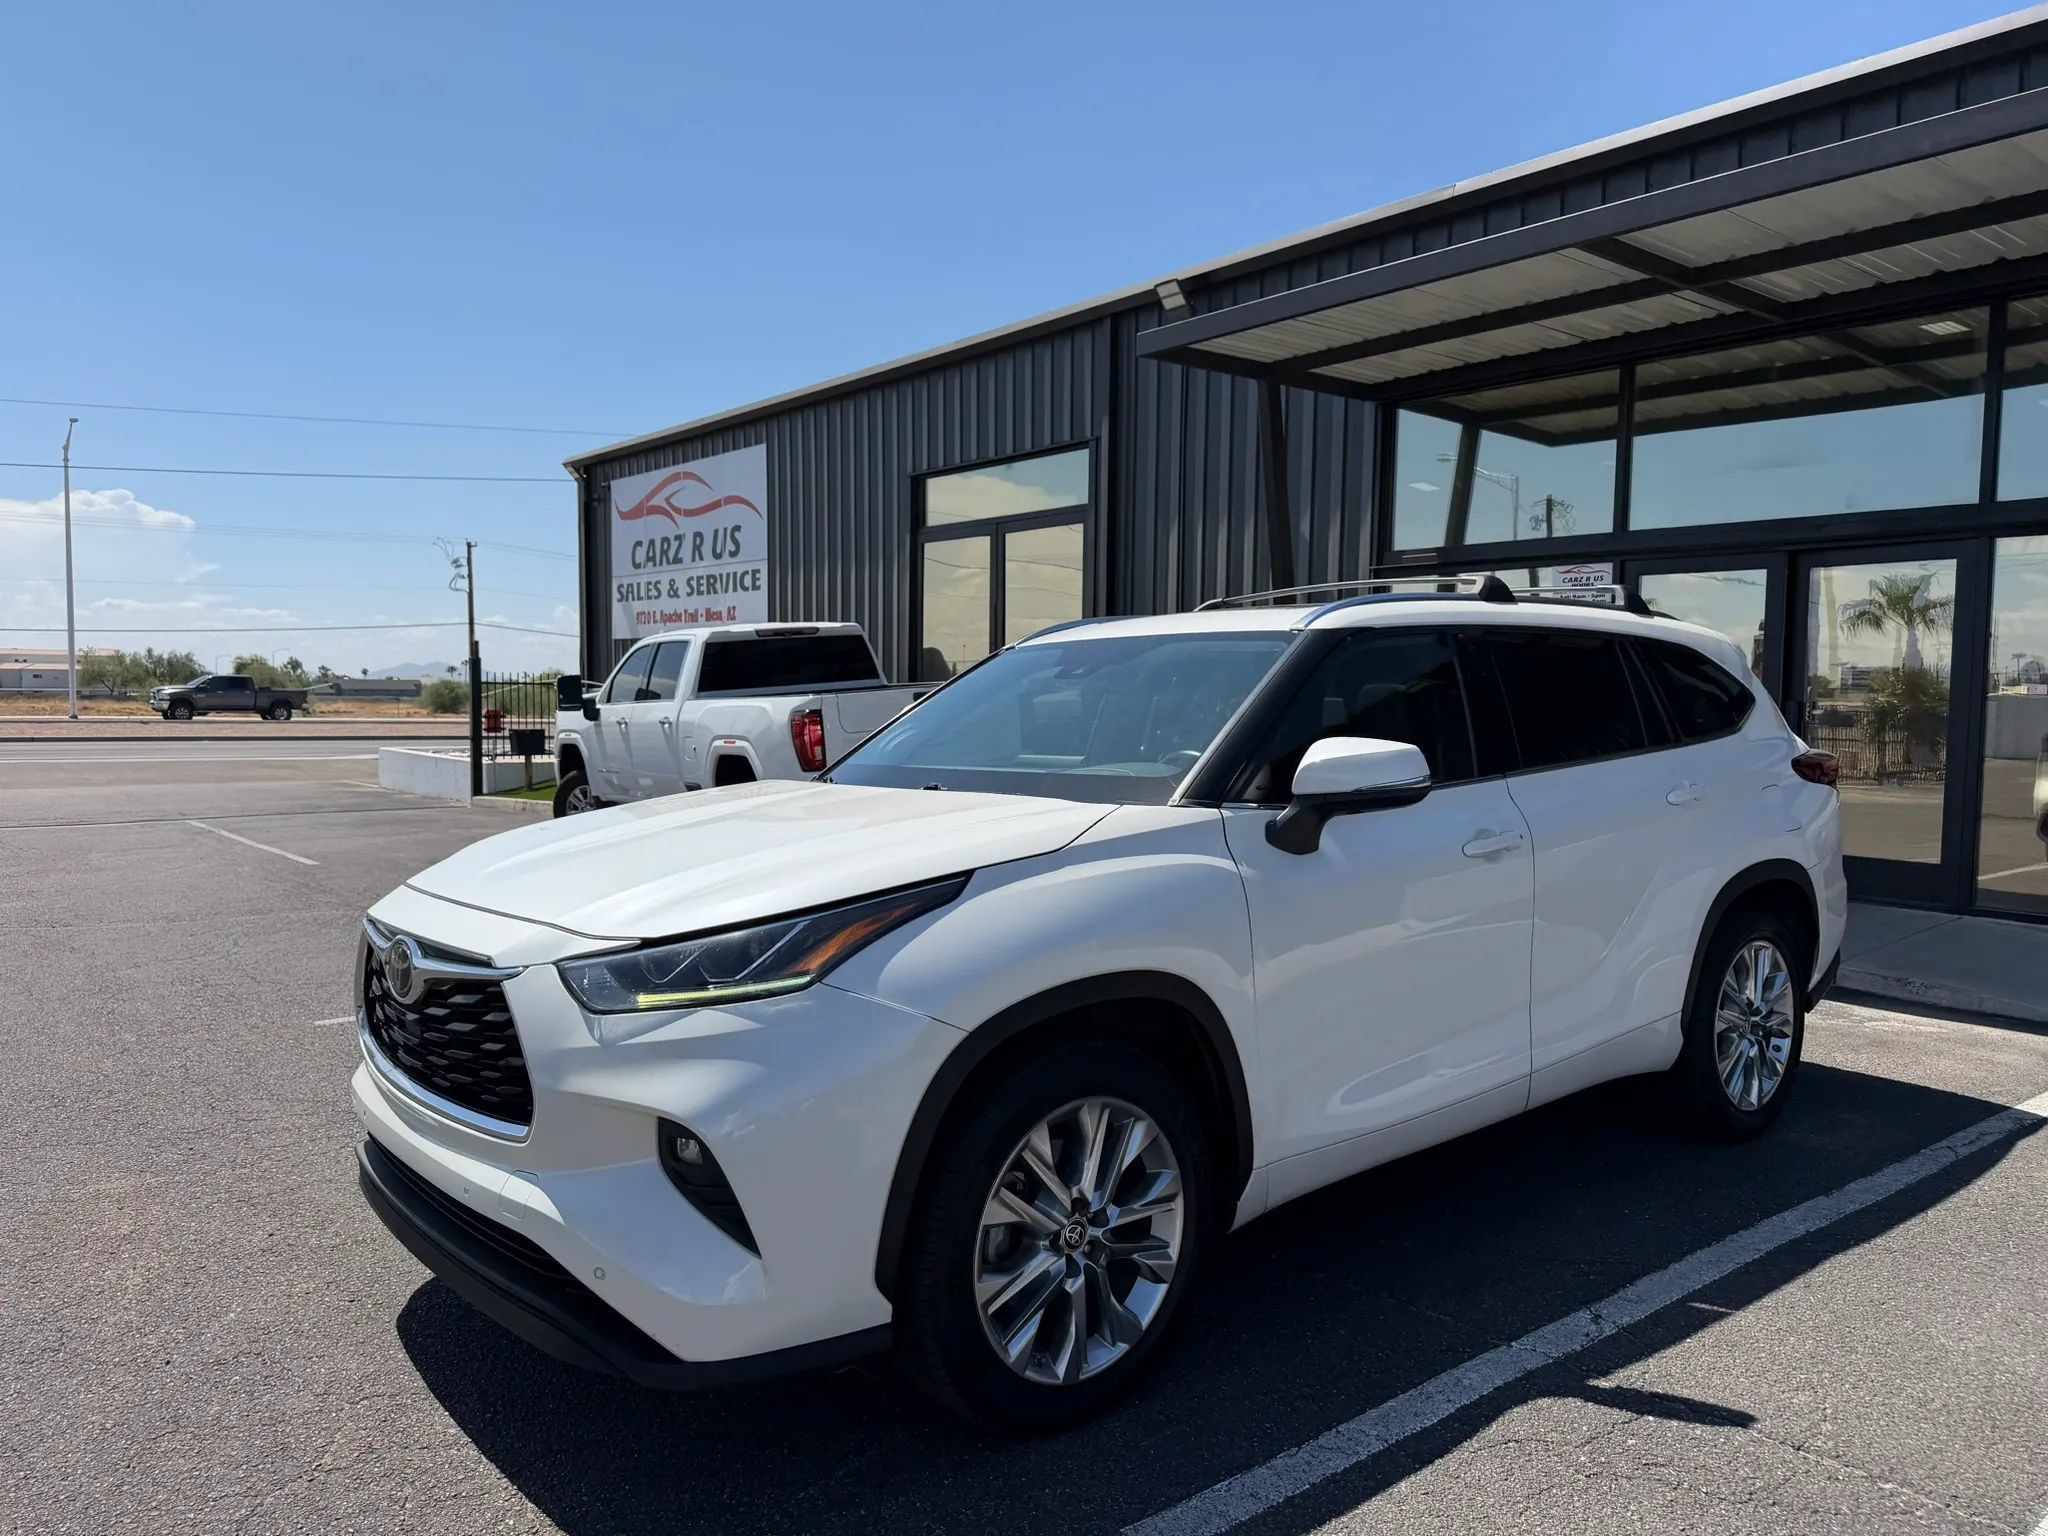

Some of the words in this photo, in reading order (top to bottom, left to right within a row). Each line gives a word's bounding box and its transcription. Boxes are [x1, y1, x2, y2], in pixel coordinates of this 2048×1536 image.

[691, 531, 705, 563] R
[711, 525, 742, 561] US
[616, 580, 662, 603] SALES
[667, 578, 680, 599] &
[686, 569, 761, 597] SERVICE
[660, 608, 682, 627] Apache
[684, 608, 699, 624] Trail
[727, 606, 737, 621] AZ
